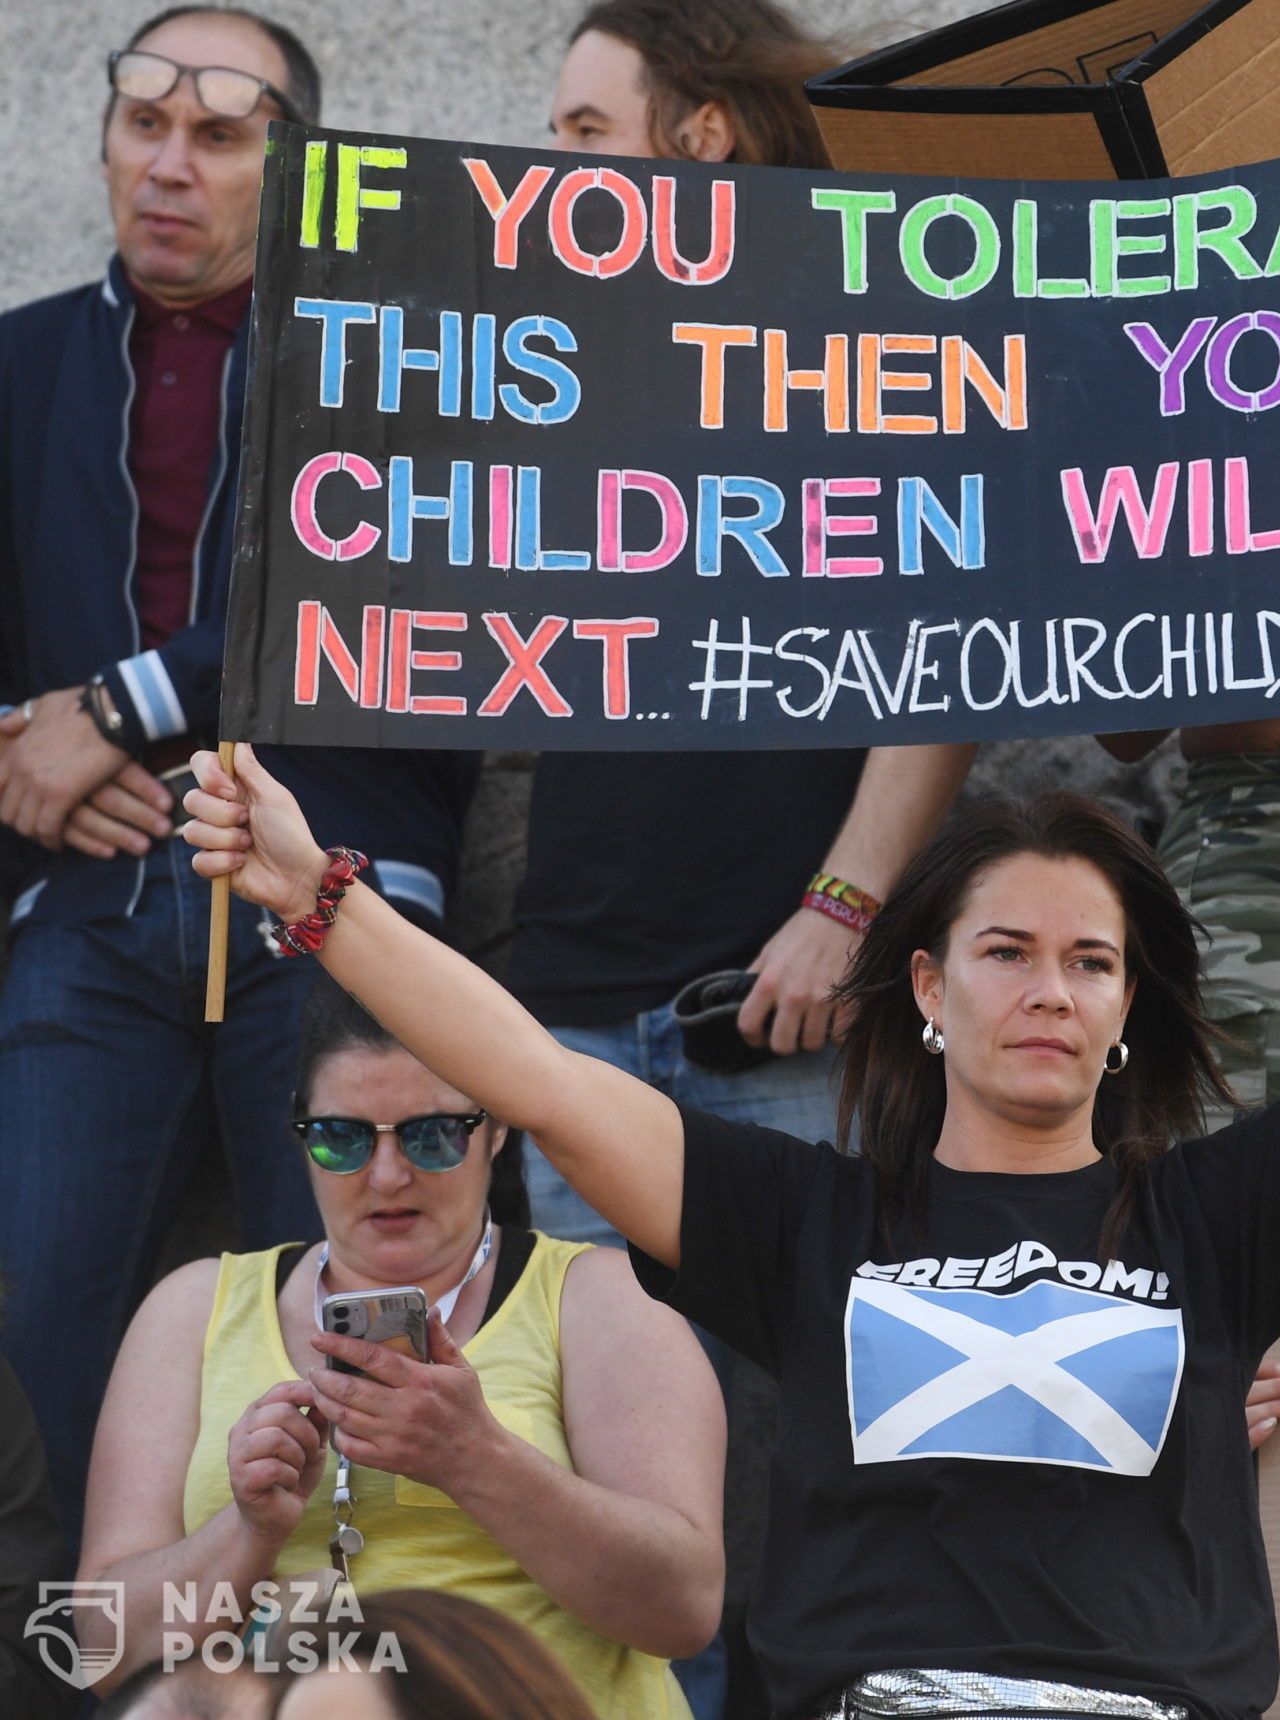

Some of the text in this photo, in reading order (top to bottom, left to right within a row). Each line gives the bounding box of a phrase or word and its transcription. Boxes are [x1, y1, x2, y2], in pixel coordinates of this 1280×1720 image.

[299, 140, 408, 253] IF
[460, 156, 738, 286] YOU
[294, 296, 582, 425] THIS
[671, 321, 1029, 435] THEN
[289, 450, 986, 579] CHILDREN
[293, 599, 672, 720] NEXT...
[855, 1240, 1171, 1301] FREEDOM!
